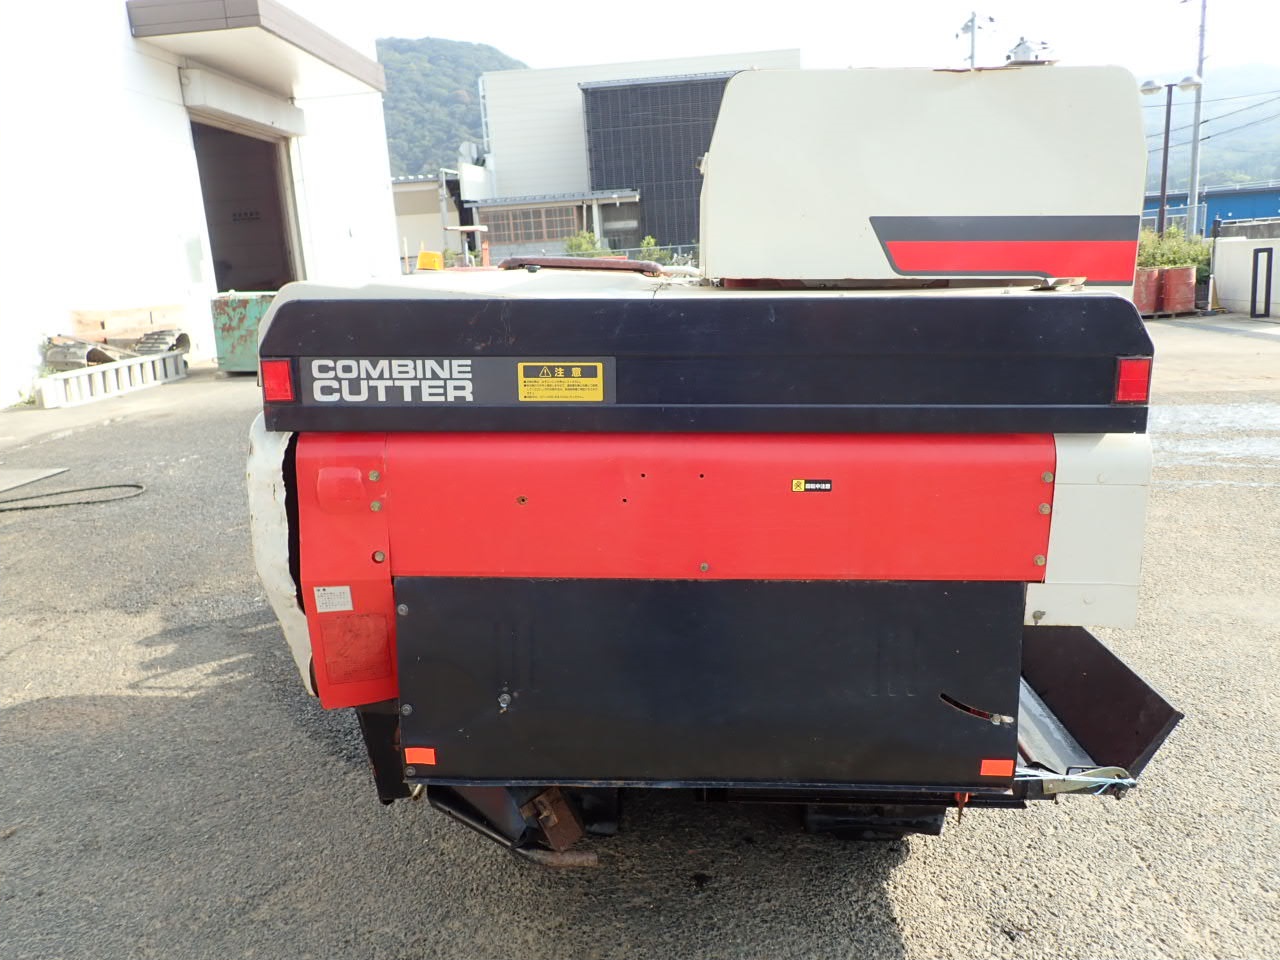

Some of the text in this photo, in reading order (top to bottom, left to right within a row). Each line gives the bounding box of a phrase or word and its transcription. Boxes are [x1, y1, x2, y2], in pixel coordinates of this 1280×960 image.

[311, 359, 473, 379] COMBINE
[554, 367, 582, 378] 注意
[312, 379, 475, 402] CUTTER
